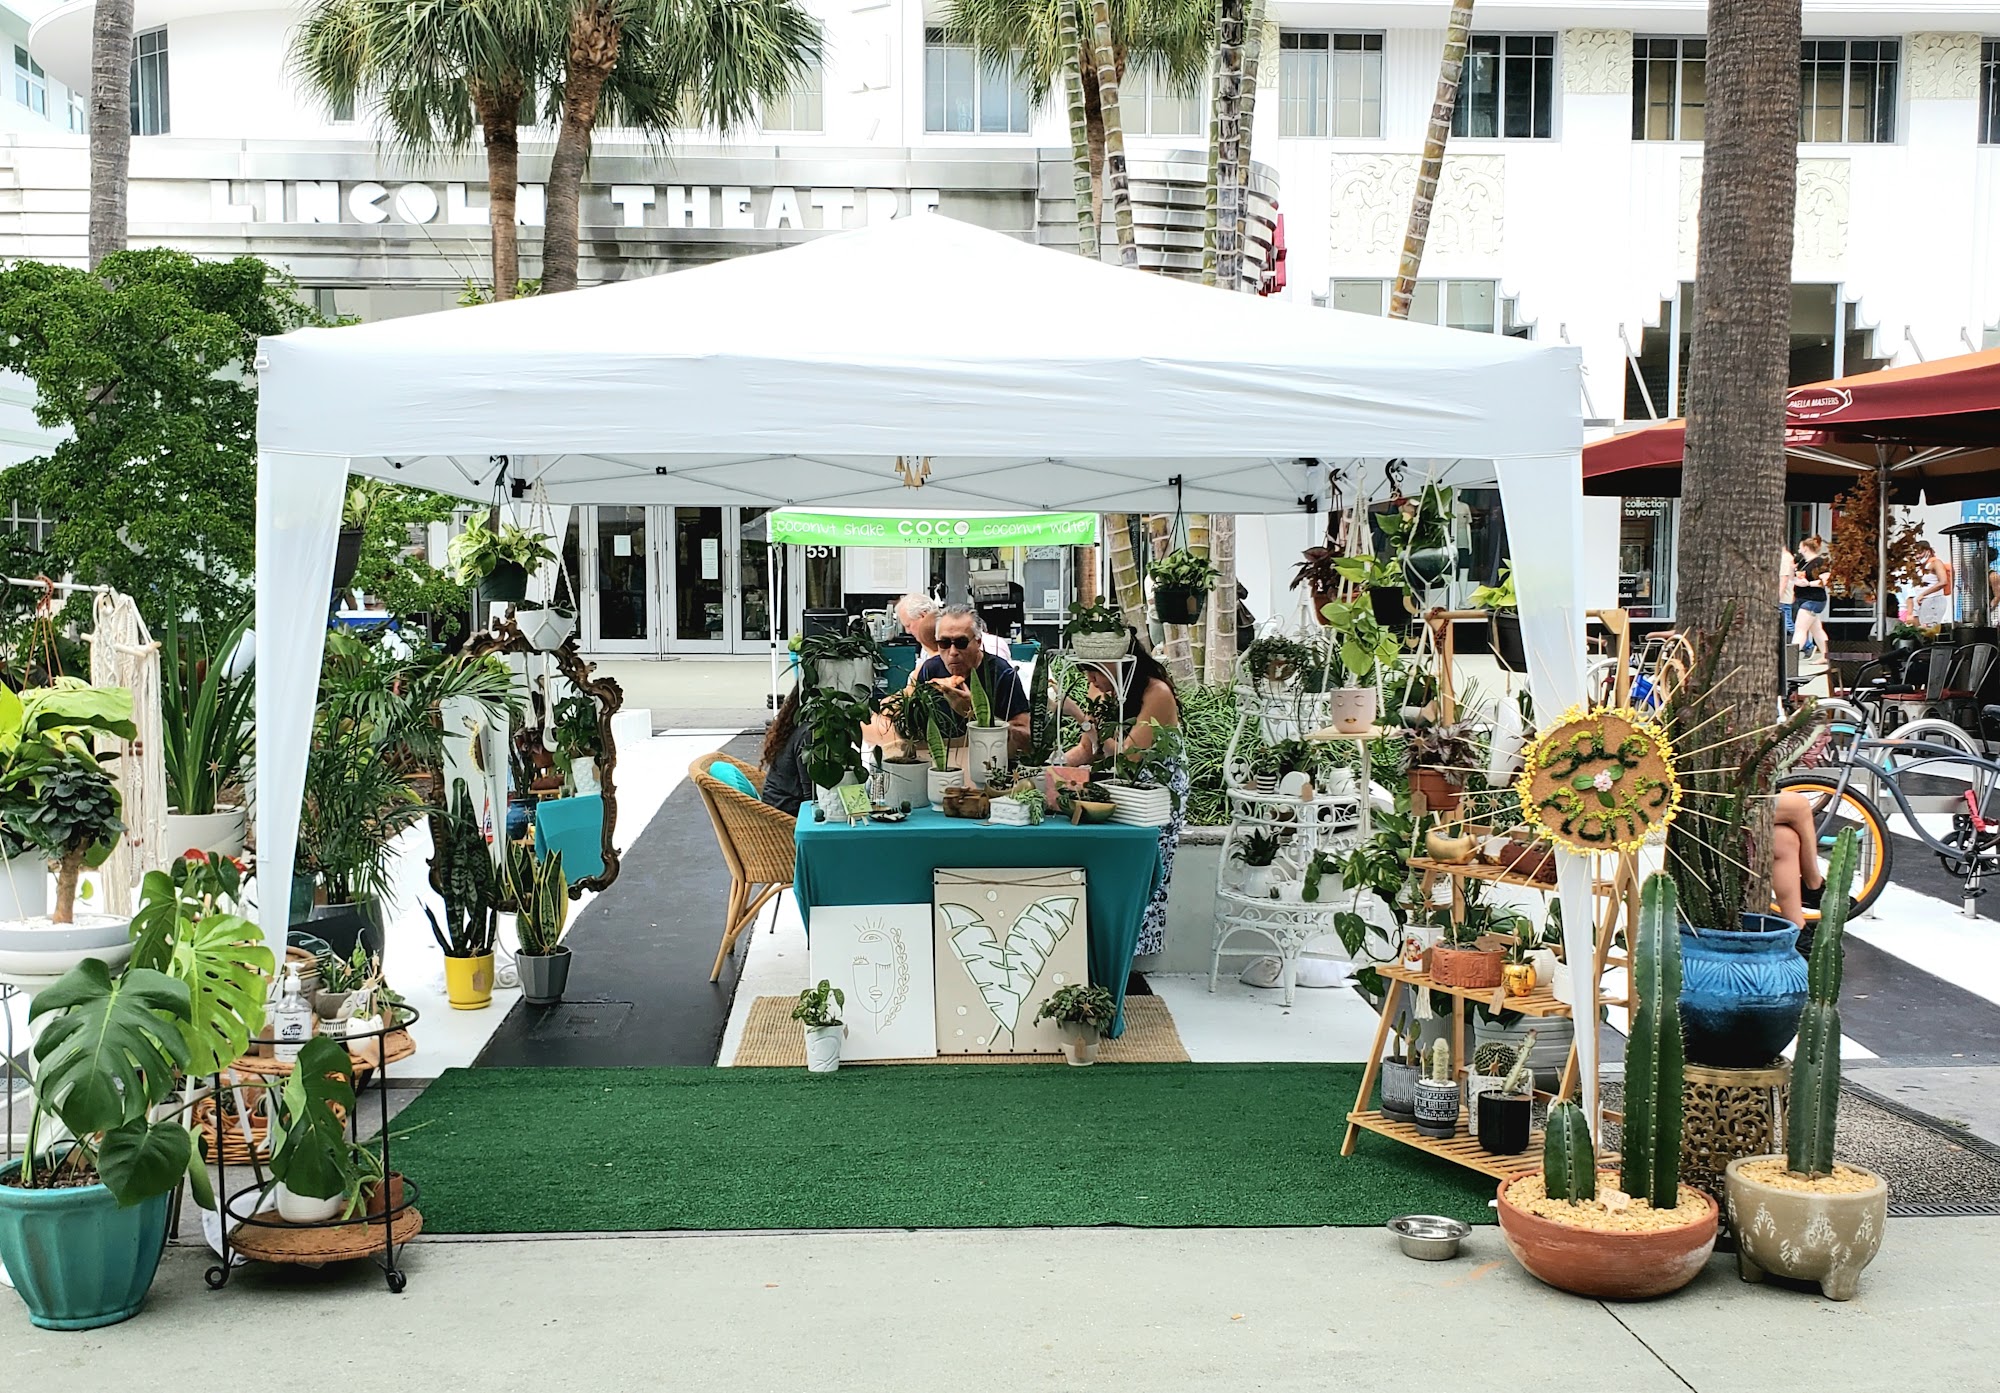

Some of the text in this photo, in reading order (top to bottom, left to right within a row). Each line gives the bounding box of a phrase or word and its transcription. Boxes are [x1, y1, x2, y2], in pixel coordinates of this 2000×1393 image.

[210, 180, 547, 225] LINCOLN
[1811, 397, 1840, 407] MASTERS
[1625, 500, 1668, 508] collection
[1625, 509, 1661, 518] to yours
[776, 520, 885, 537] coconut shake
[897, 519, 970, 536] COCO
[983, 520, 1094, 536] coconut water
[806, 546, 838, 558] 551
